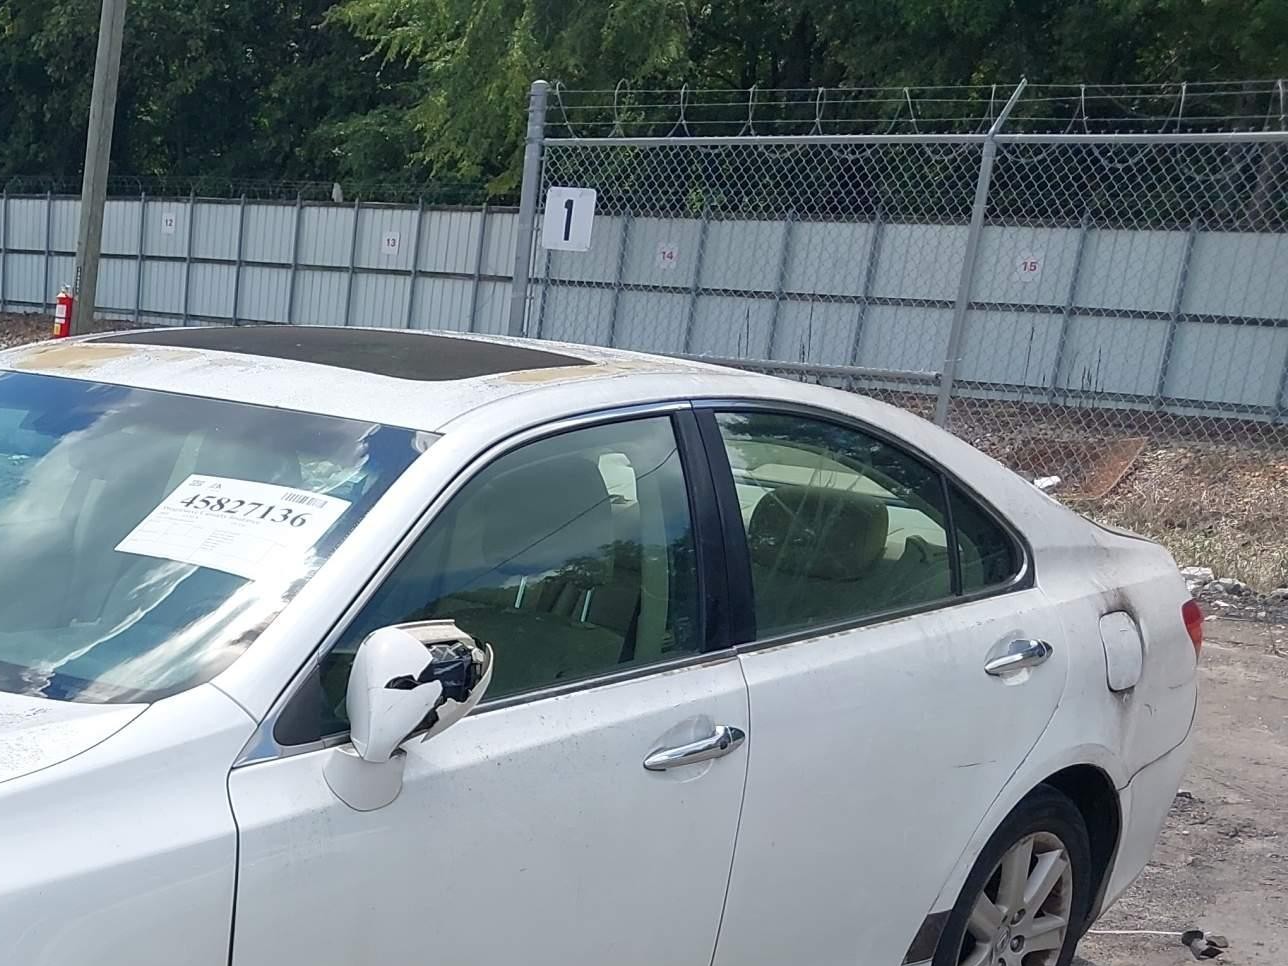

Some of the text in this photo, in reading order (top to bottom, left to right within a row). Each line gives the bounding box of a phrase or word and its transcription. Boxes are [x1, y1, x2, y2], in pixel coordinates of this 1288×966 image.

[563, 199, 574, 241] 1
[1022, 261, 1037, 272] 15
[180, 494, 312, 527] 45827136
